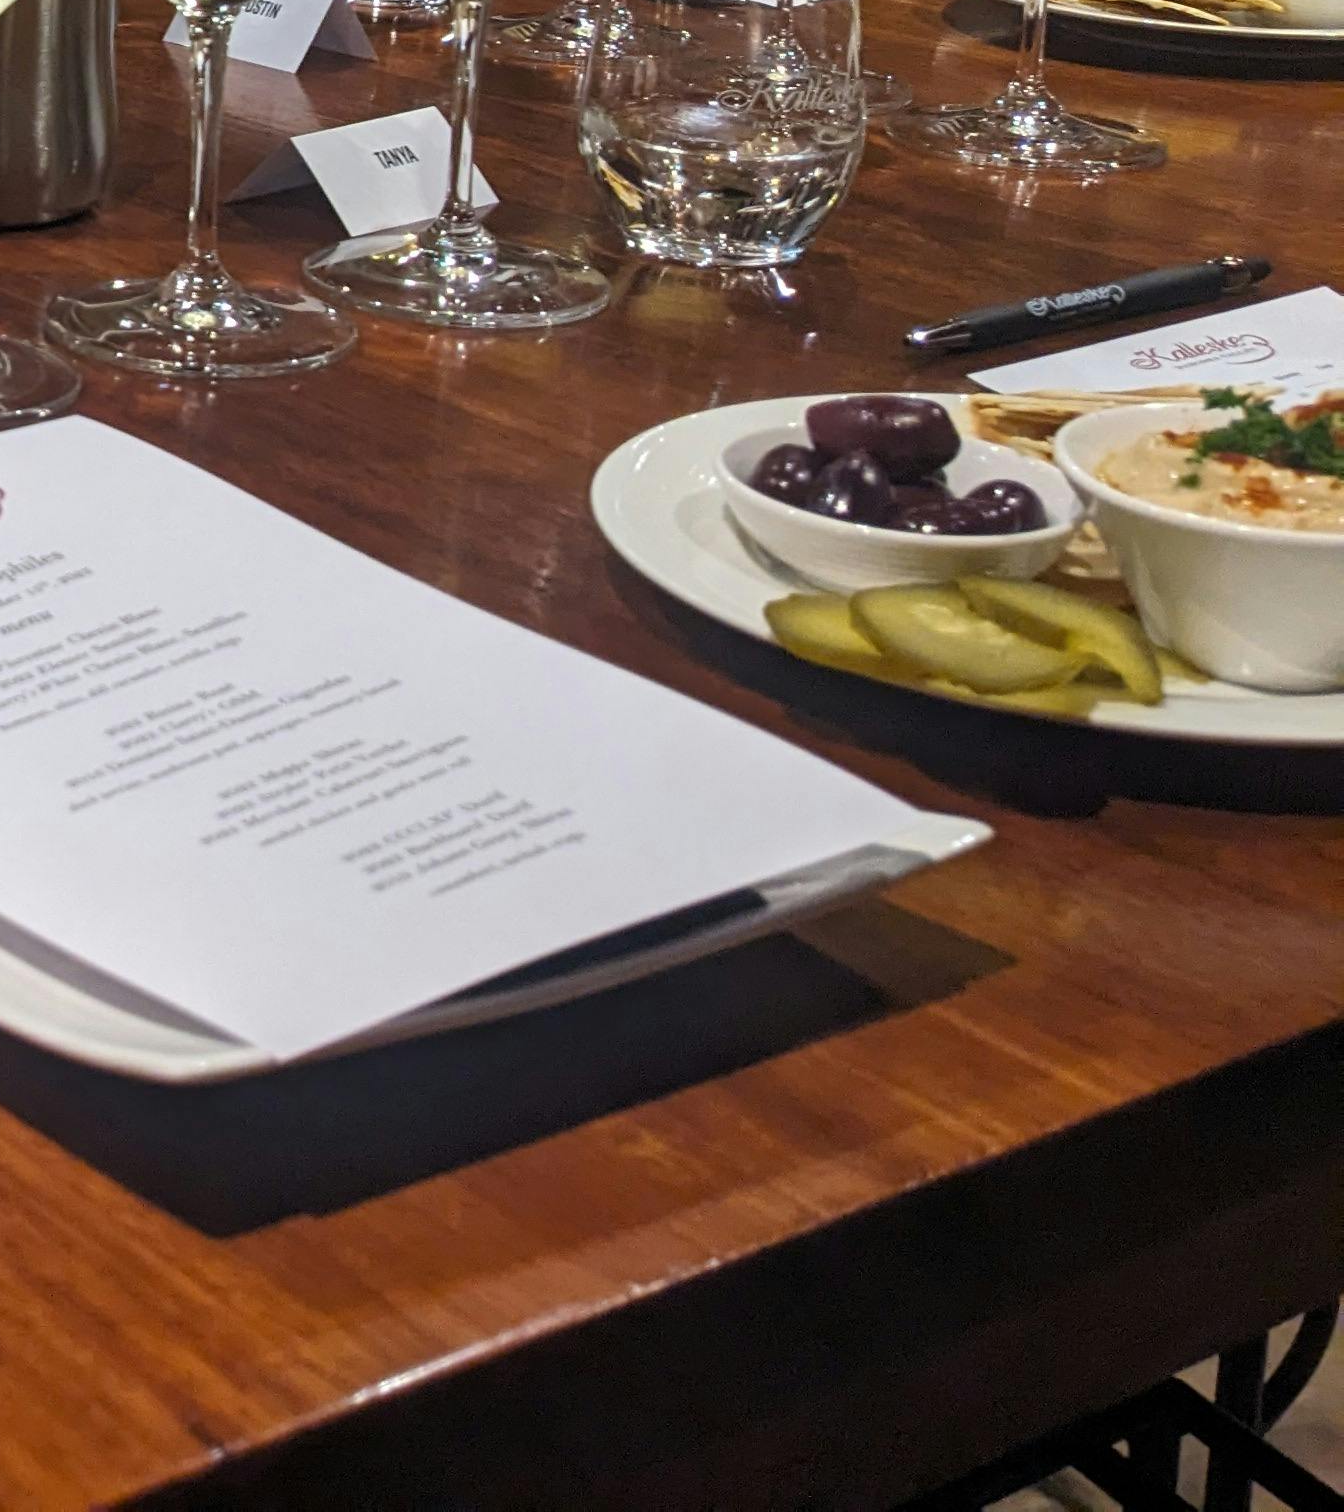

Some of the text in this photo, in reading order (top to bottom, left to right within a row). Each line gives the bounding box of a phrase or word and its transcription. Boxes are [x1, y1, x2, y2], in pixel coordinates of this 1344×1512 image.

[373, 144, 420, 170] TANYA
[1025, 285, 1126, 317] Kalleske
[1129, 333, 1275, 370] Kalleske
